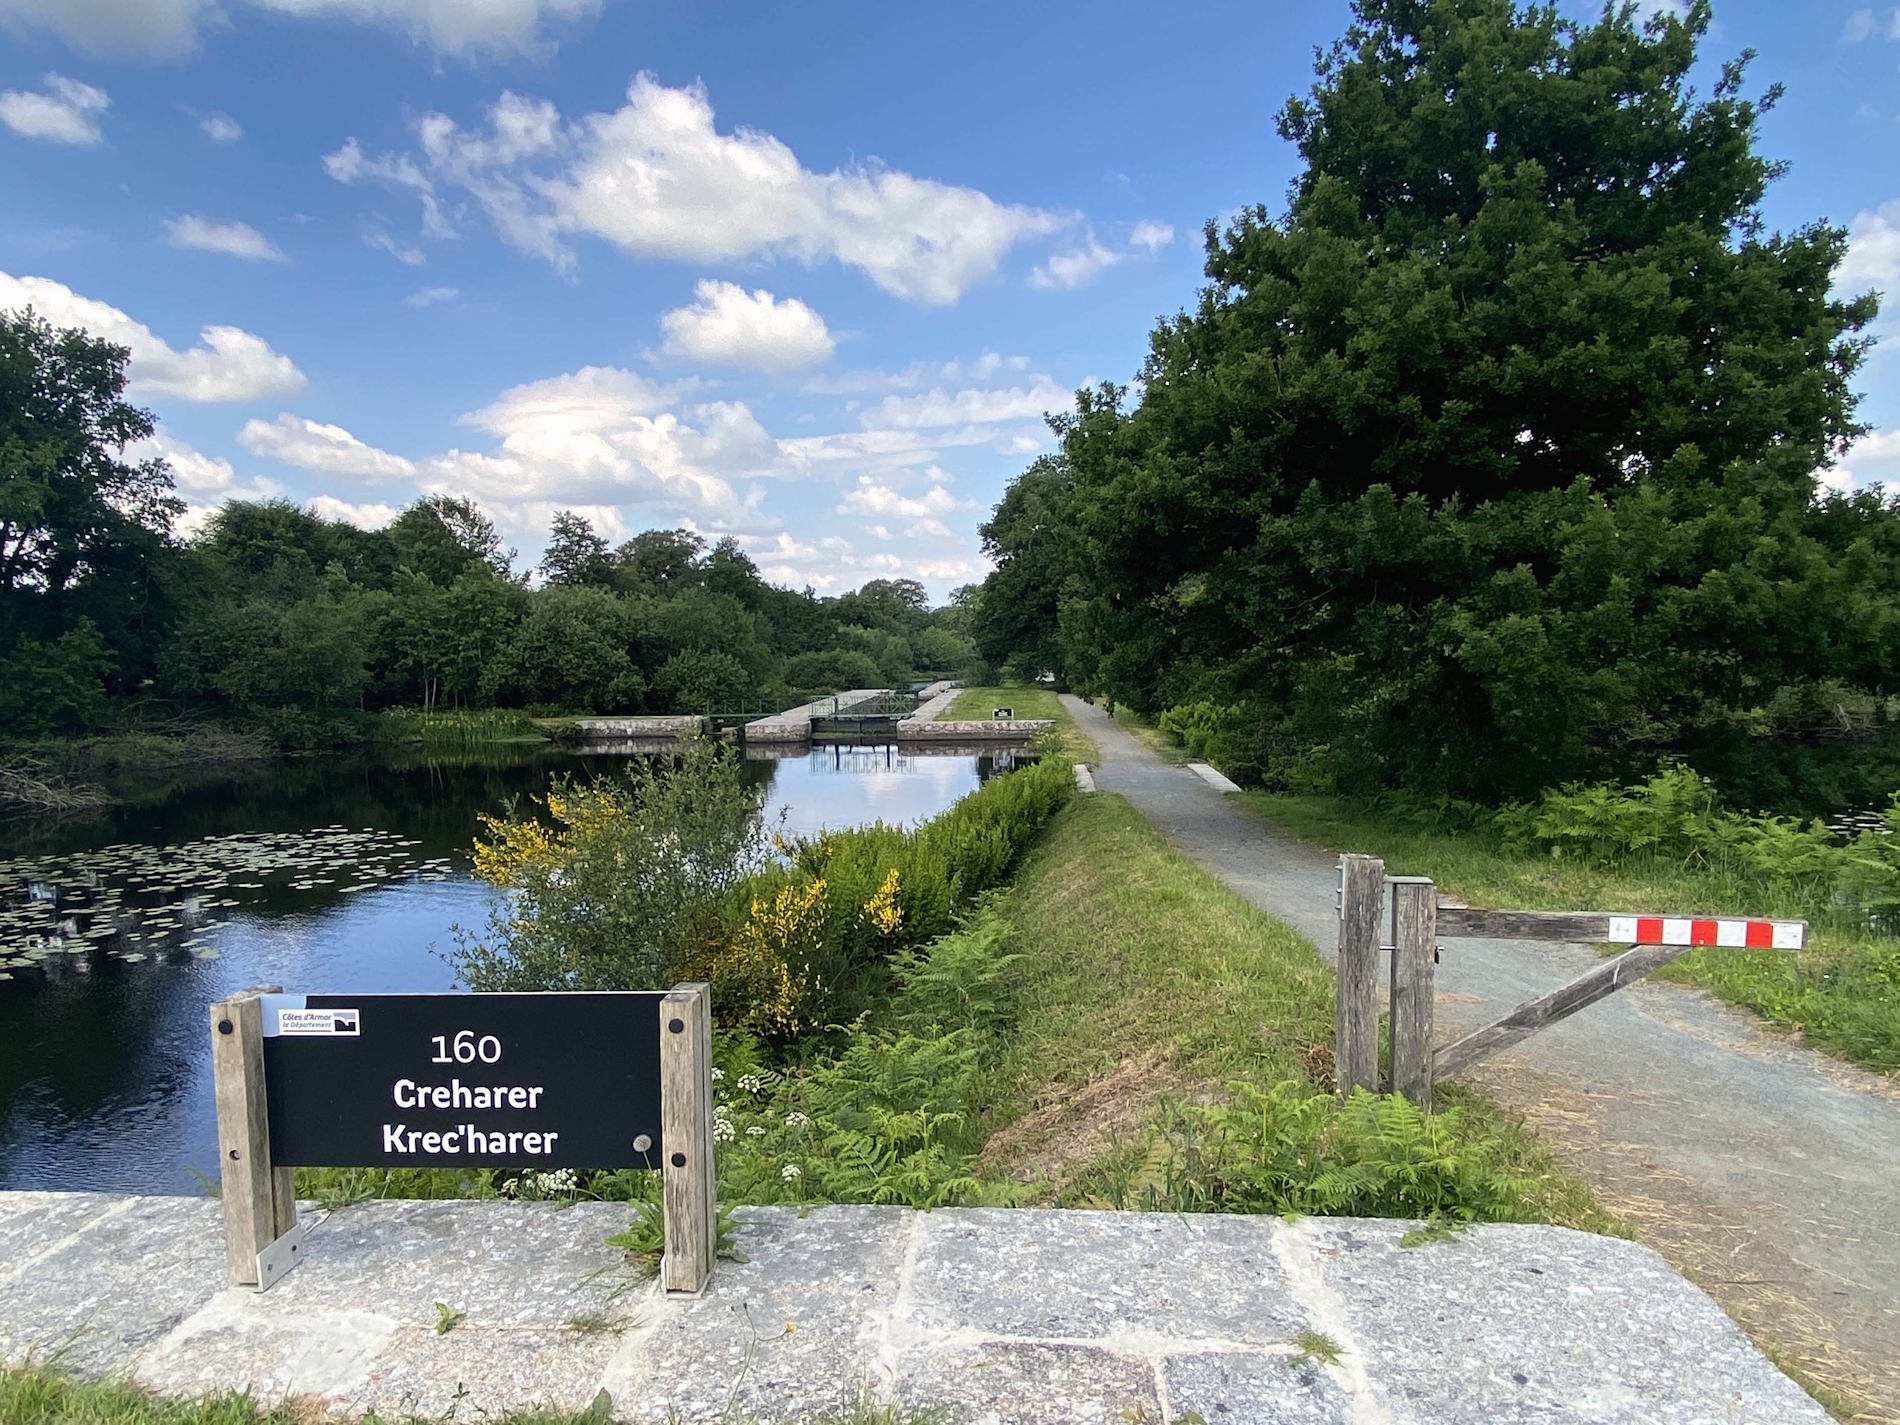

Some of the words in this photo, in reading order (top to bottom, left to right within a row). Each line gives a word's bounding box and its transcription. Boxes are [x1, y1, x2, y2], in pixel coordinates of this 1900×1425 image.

[282, 1013, 302, 1021] Côtes
[303, 1013, 332, 1021] d'Armor
[290, 1021, 331, 1029] Département
[432, 1031, 501, 1063] 160
[394, 1079, 543, 1108] Creharer
[384, 1124, 558, 1154] Krec'harer
